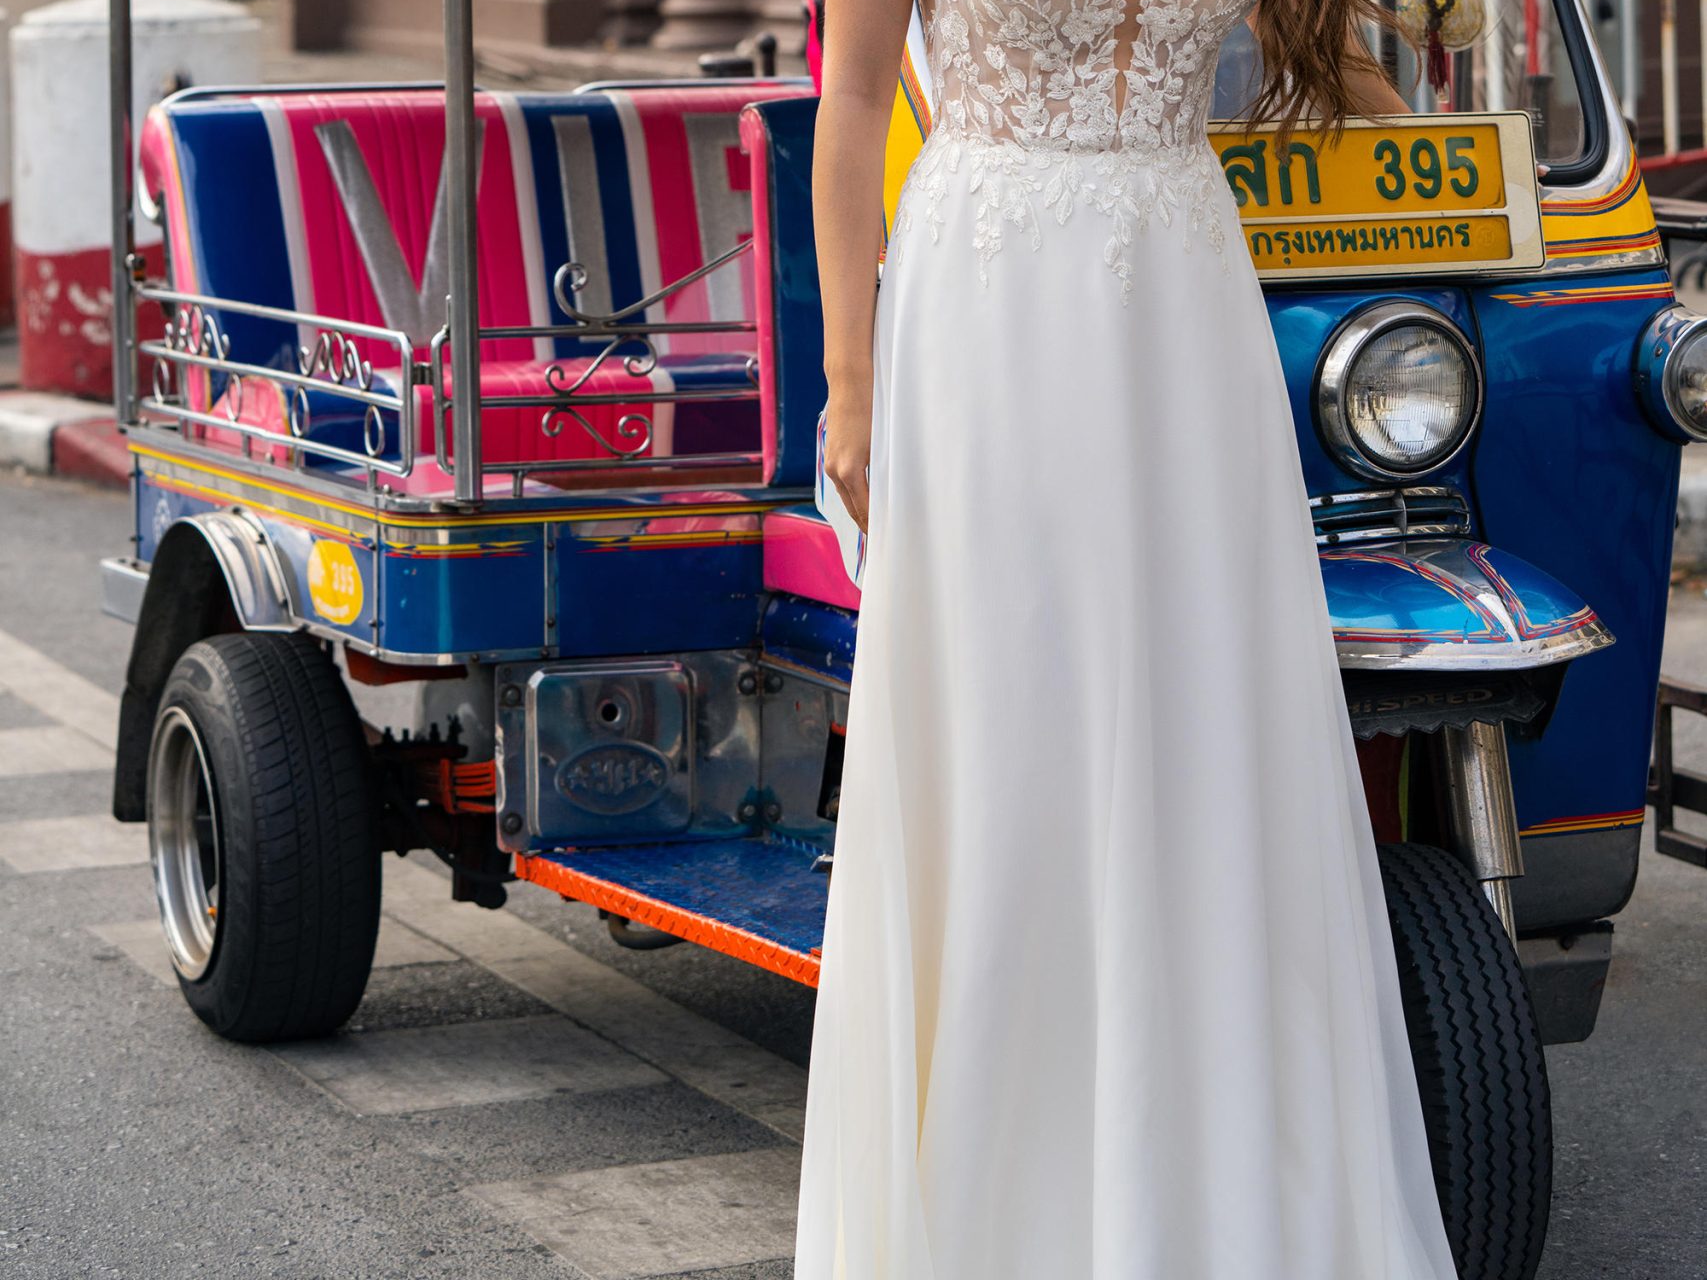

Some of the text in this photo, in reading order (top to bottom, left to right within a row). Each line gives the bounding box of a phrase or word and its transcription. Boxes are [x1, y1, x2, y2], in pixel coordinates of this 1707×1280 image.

[1221, 137, 1479, 208] สก 395
[1250, 223, 1471, 265] กรุงเทพมหานคร
